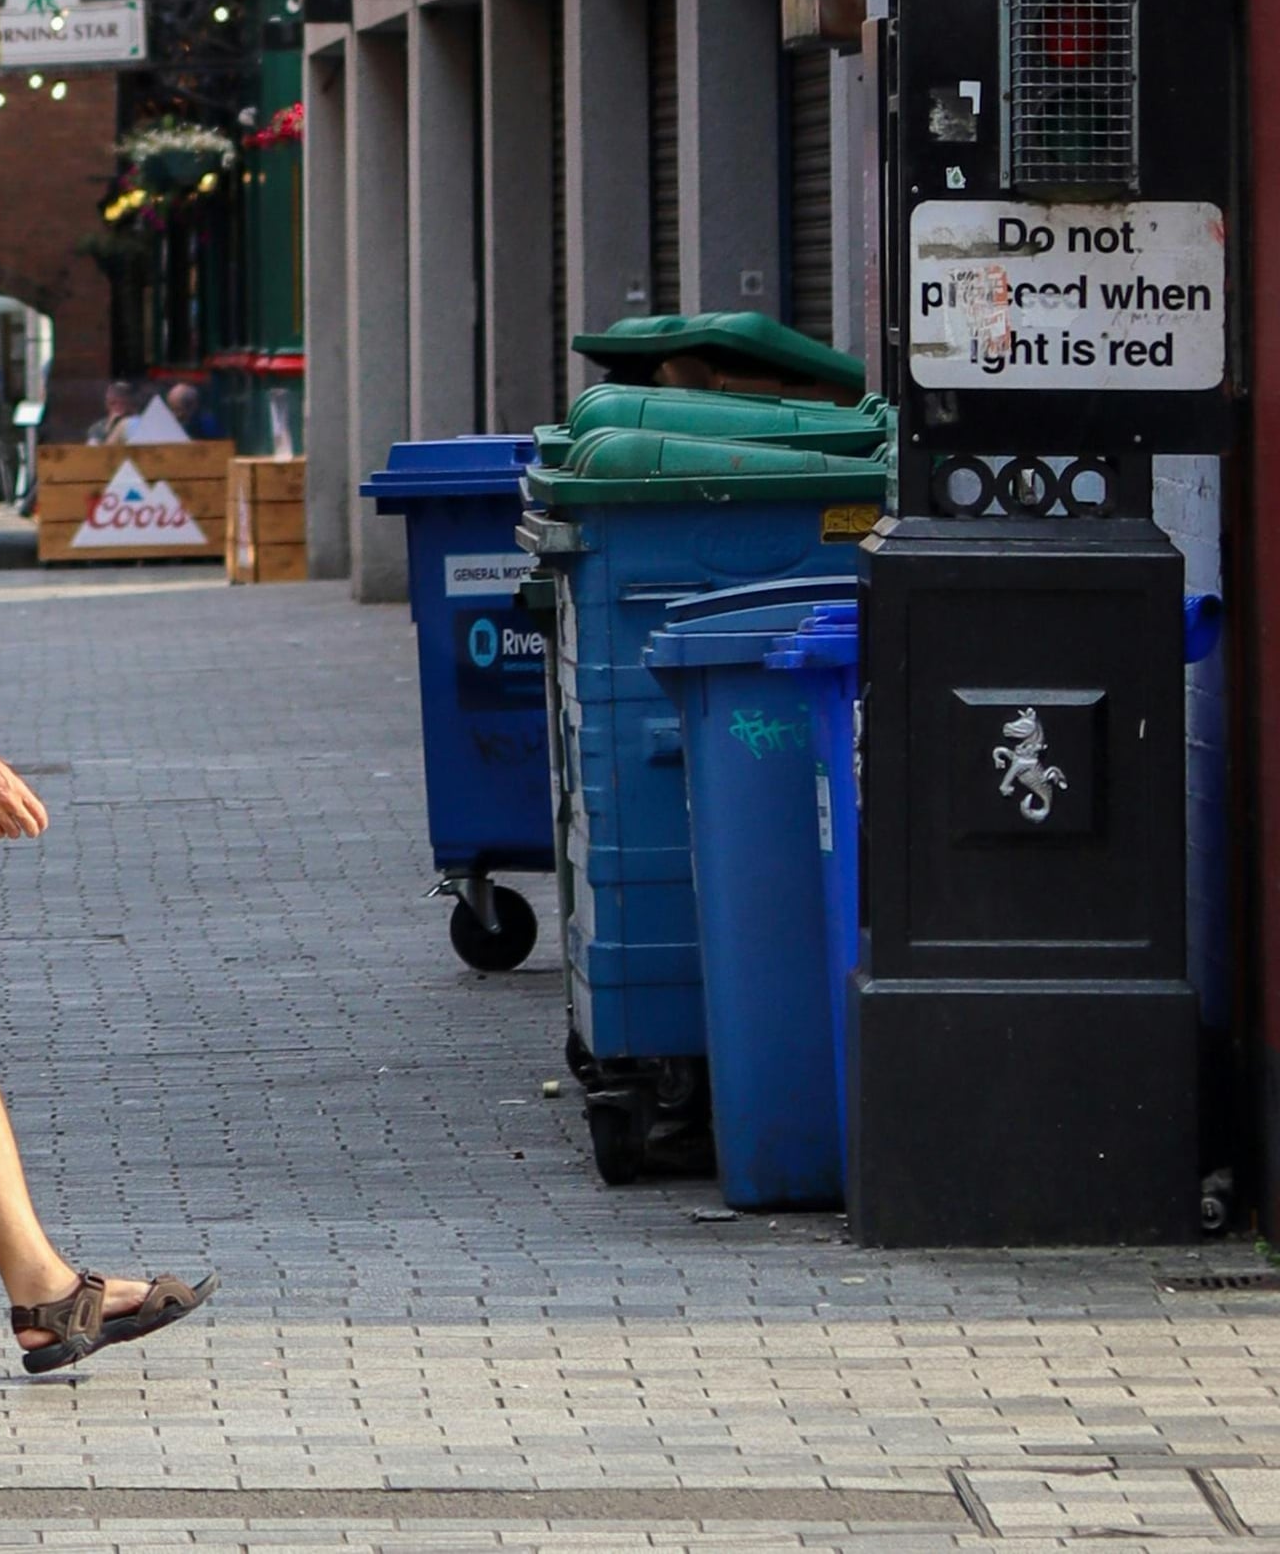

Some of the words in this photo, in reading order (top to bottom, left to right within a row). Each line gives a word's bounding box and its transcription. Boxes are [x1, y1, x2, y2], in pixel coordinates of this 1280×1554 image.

[74, 23, 120, 39] STAR
[997, 217, 1055, 254] Do
[1067, 221, 1134, 254] not
[1100, 275, 1211, 311] when
[1061, 330, 1096, 366] is
[1109, 332, 1173, 367] red
[86, 493, 191, 530] Coors
[453, 567, 501, 582] GENERAL
